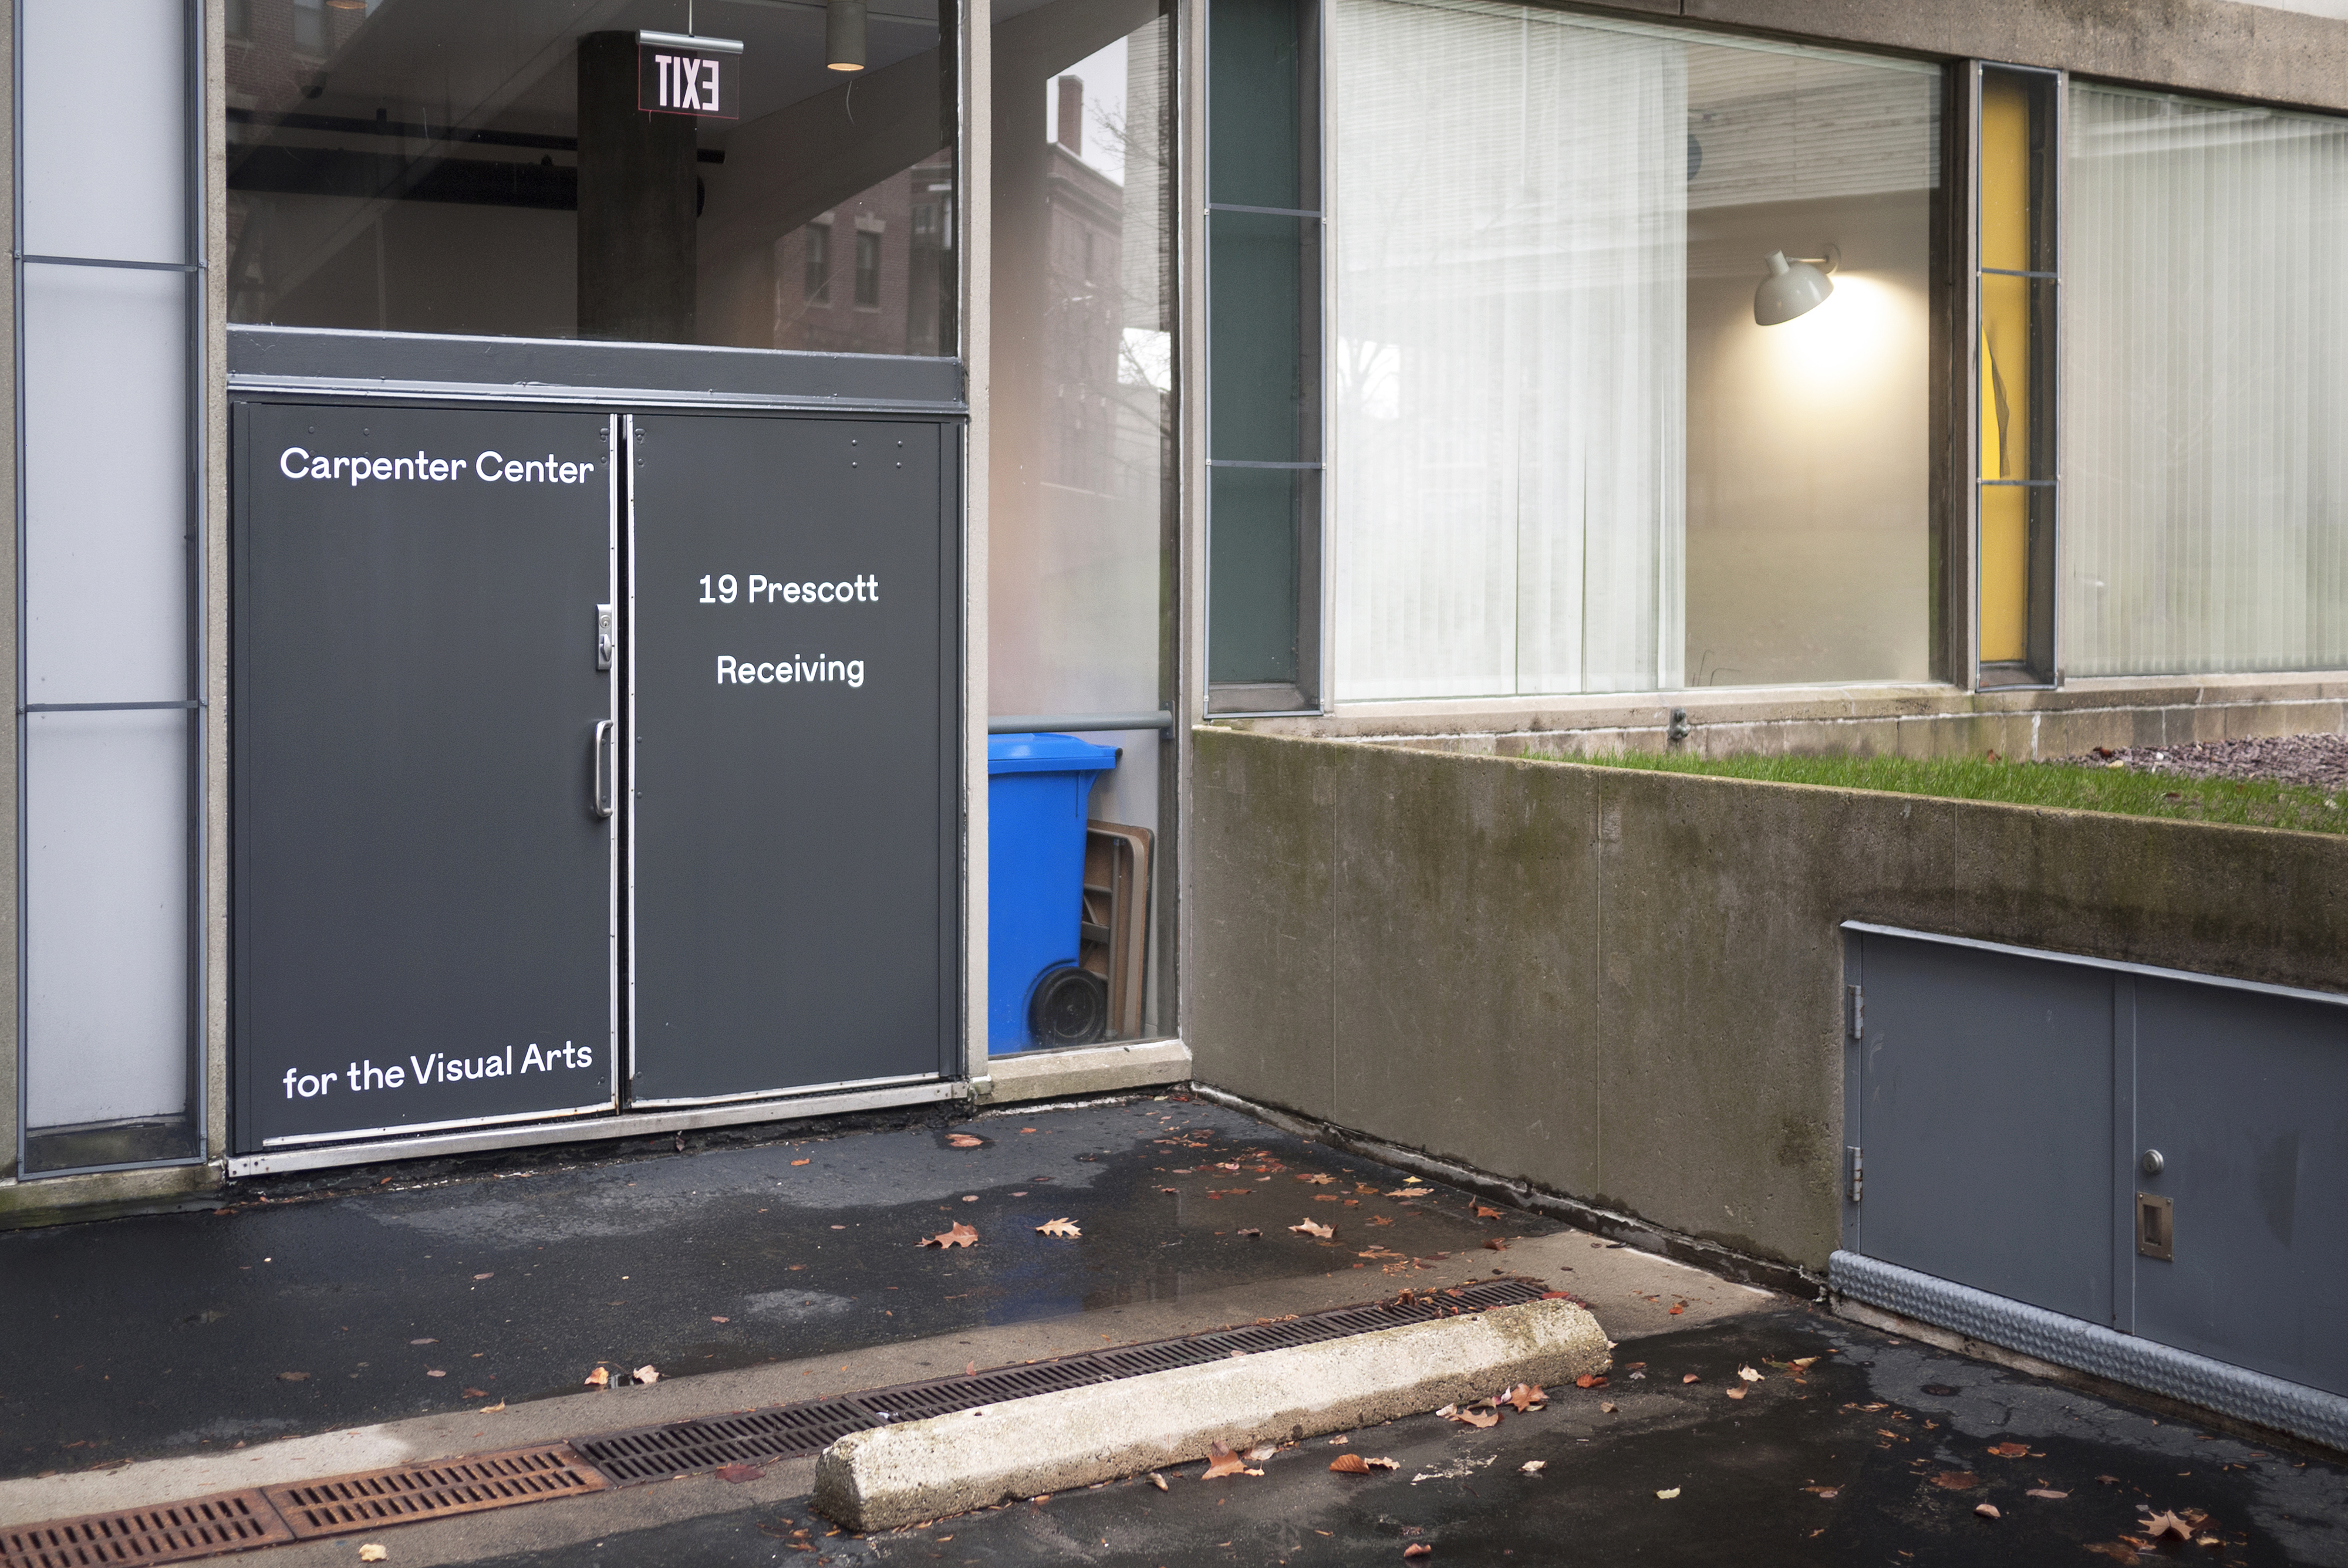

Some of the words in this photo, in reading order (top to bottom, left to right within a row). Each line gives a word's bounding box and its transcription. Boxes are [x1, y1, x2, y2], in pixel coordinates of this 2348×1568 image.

[280, 447, 467, 487] Carpenter
[475, 450, 595, 485] Center
[699, 574, 738, 604] 19
[748, 573, 880, 604] Prescott
[717, 653, 865, 689] Receiving
[282, 1067, 338, 1099] for
[346, 1059, 405, 1092] the
[410, 1045, 512, 1085] Visual
[520, 1040, 593, 1074] Arts
